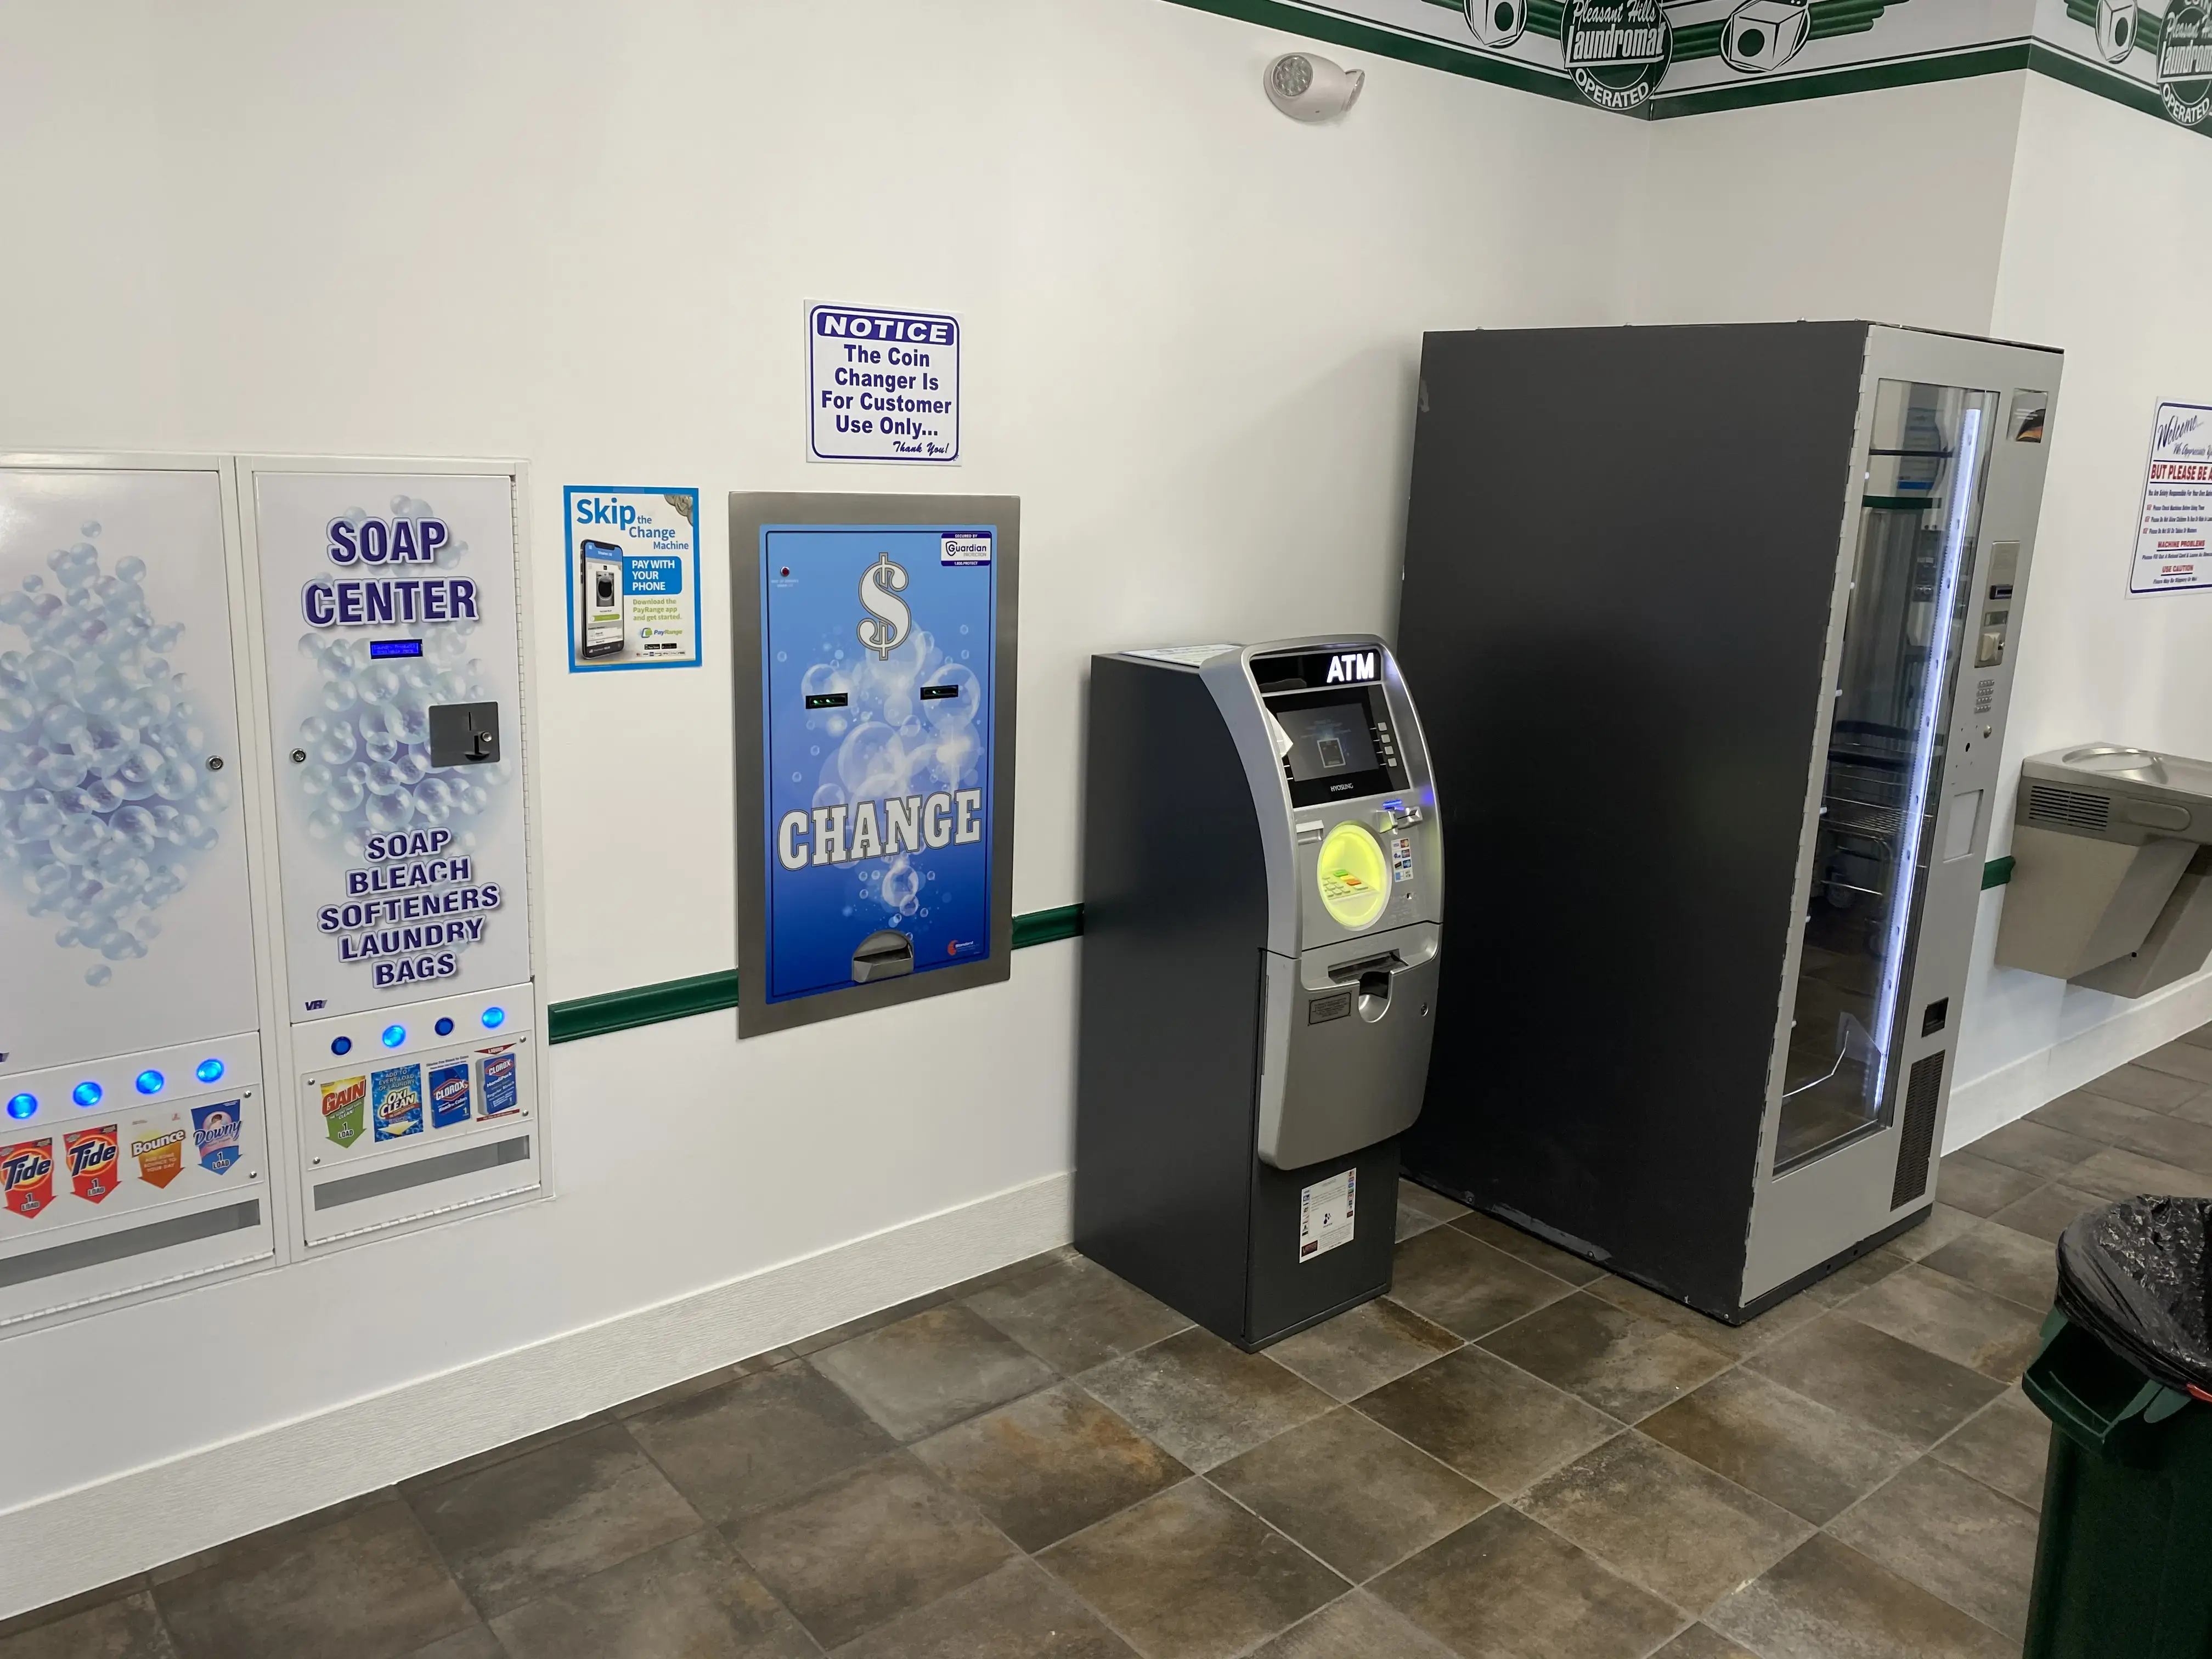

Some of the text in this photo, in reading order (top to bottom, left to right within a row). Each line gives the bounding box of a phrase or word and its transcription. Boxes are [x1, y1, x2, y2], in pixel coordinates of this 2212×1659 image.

[1573, 1, 1656, 23] Pleasant Hills
[1565, 22, 1666, 67] Laundromat
[2158, 40, 2212, 82] Laundrom
[1576, 68, 1649, 108] OPERATED
[2163, 83, 2210, 123] OPERATED
[824, 315, 949, 343] NOTICE
[844, 344, 929, 367] The Coin
[835, 367, 939, 393] Changer Is
[822, 390, 952, 414] For Customer
[836, 415, 938, 439] Use Only...
[2158, 415, 2204, 451] Welcome
[893, 441, 950, 456] Thank You!
[2151, 464, 2168, 479] BUT
[2168, 465, 2197, 480] PLEASE
[2197, 466, 2208, 480] BE
[577, 498, 652, 531] Skip the
[329, 518, 447, 563] SOAP
[629, 526, 675, 541] Change
[653, 541, 689, 550] Machine
[948, 544, 986, 552] Guardian
[632, 560, 675, 569] PAY WITH
[632, 571, 659, 580] YOUR
[633, 582, 666, 591] PHONE
[304, 578, 478, 625] CENTER
[856, 552, 912, 661] $
[1327, 652, 1374, 683] ATM
[1330, 783, 1353, 792] HYOSUNG
[777, 787, 983, 871] CHANGE
[367, 829, 449, 860] SOAP
[348, 857, 469, 895] BLEACH
[320, 885, 498, 930] SOFTENERS
[341, 917, 483, 960] LAUNDRY
[375, 952, 454, 986] BAGS
[489, 1059, 511, 1076] CLOROX
[387, 1088, 408, 1104] OXI
[388, 1080, 415, 1090] LAUNDRY
[436, 1080, 465, 1101] CLOROX
[322, 1080, 365, 1115] GAIN
[379, 1094, 415, 1117] CLEAN
[193, 1121, 242, 1146] Downy
[338, 1130, 353, 1138] LOAD
[343, 1122, 347, 1130] 1
[133, 1130, 184, 1156] Bounce
[69, 1141, 116, 1177] Tide
[213, 1160, 229, 1169] LOAD
[217, 1152, 222, 1160] 1
[2, 1154, 51, 1192] Tide
[92, 1178, 98, 1187] 1
[26, 1193, 32, 1202] 1
[88, 1187, 105, 1196] LOAD
